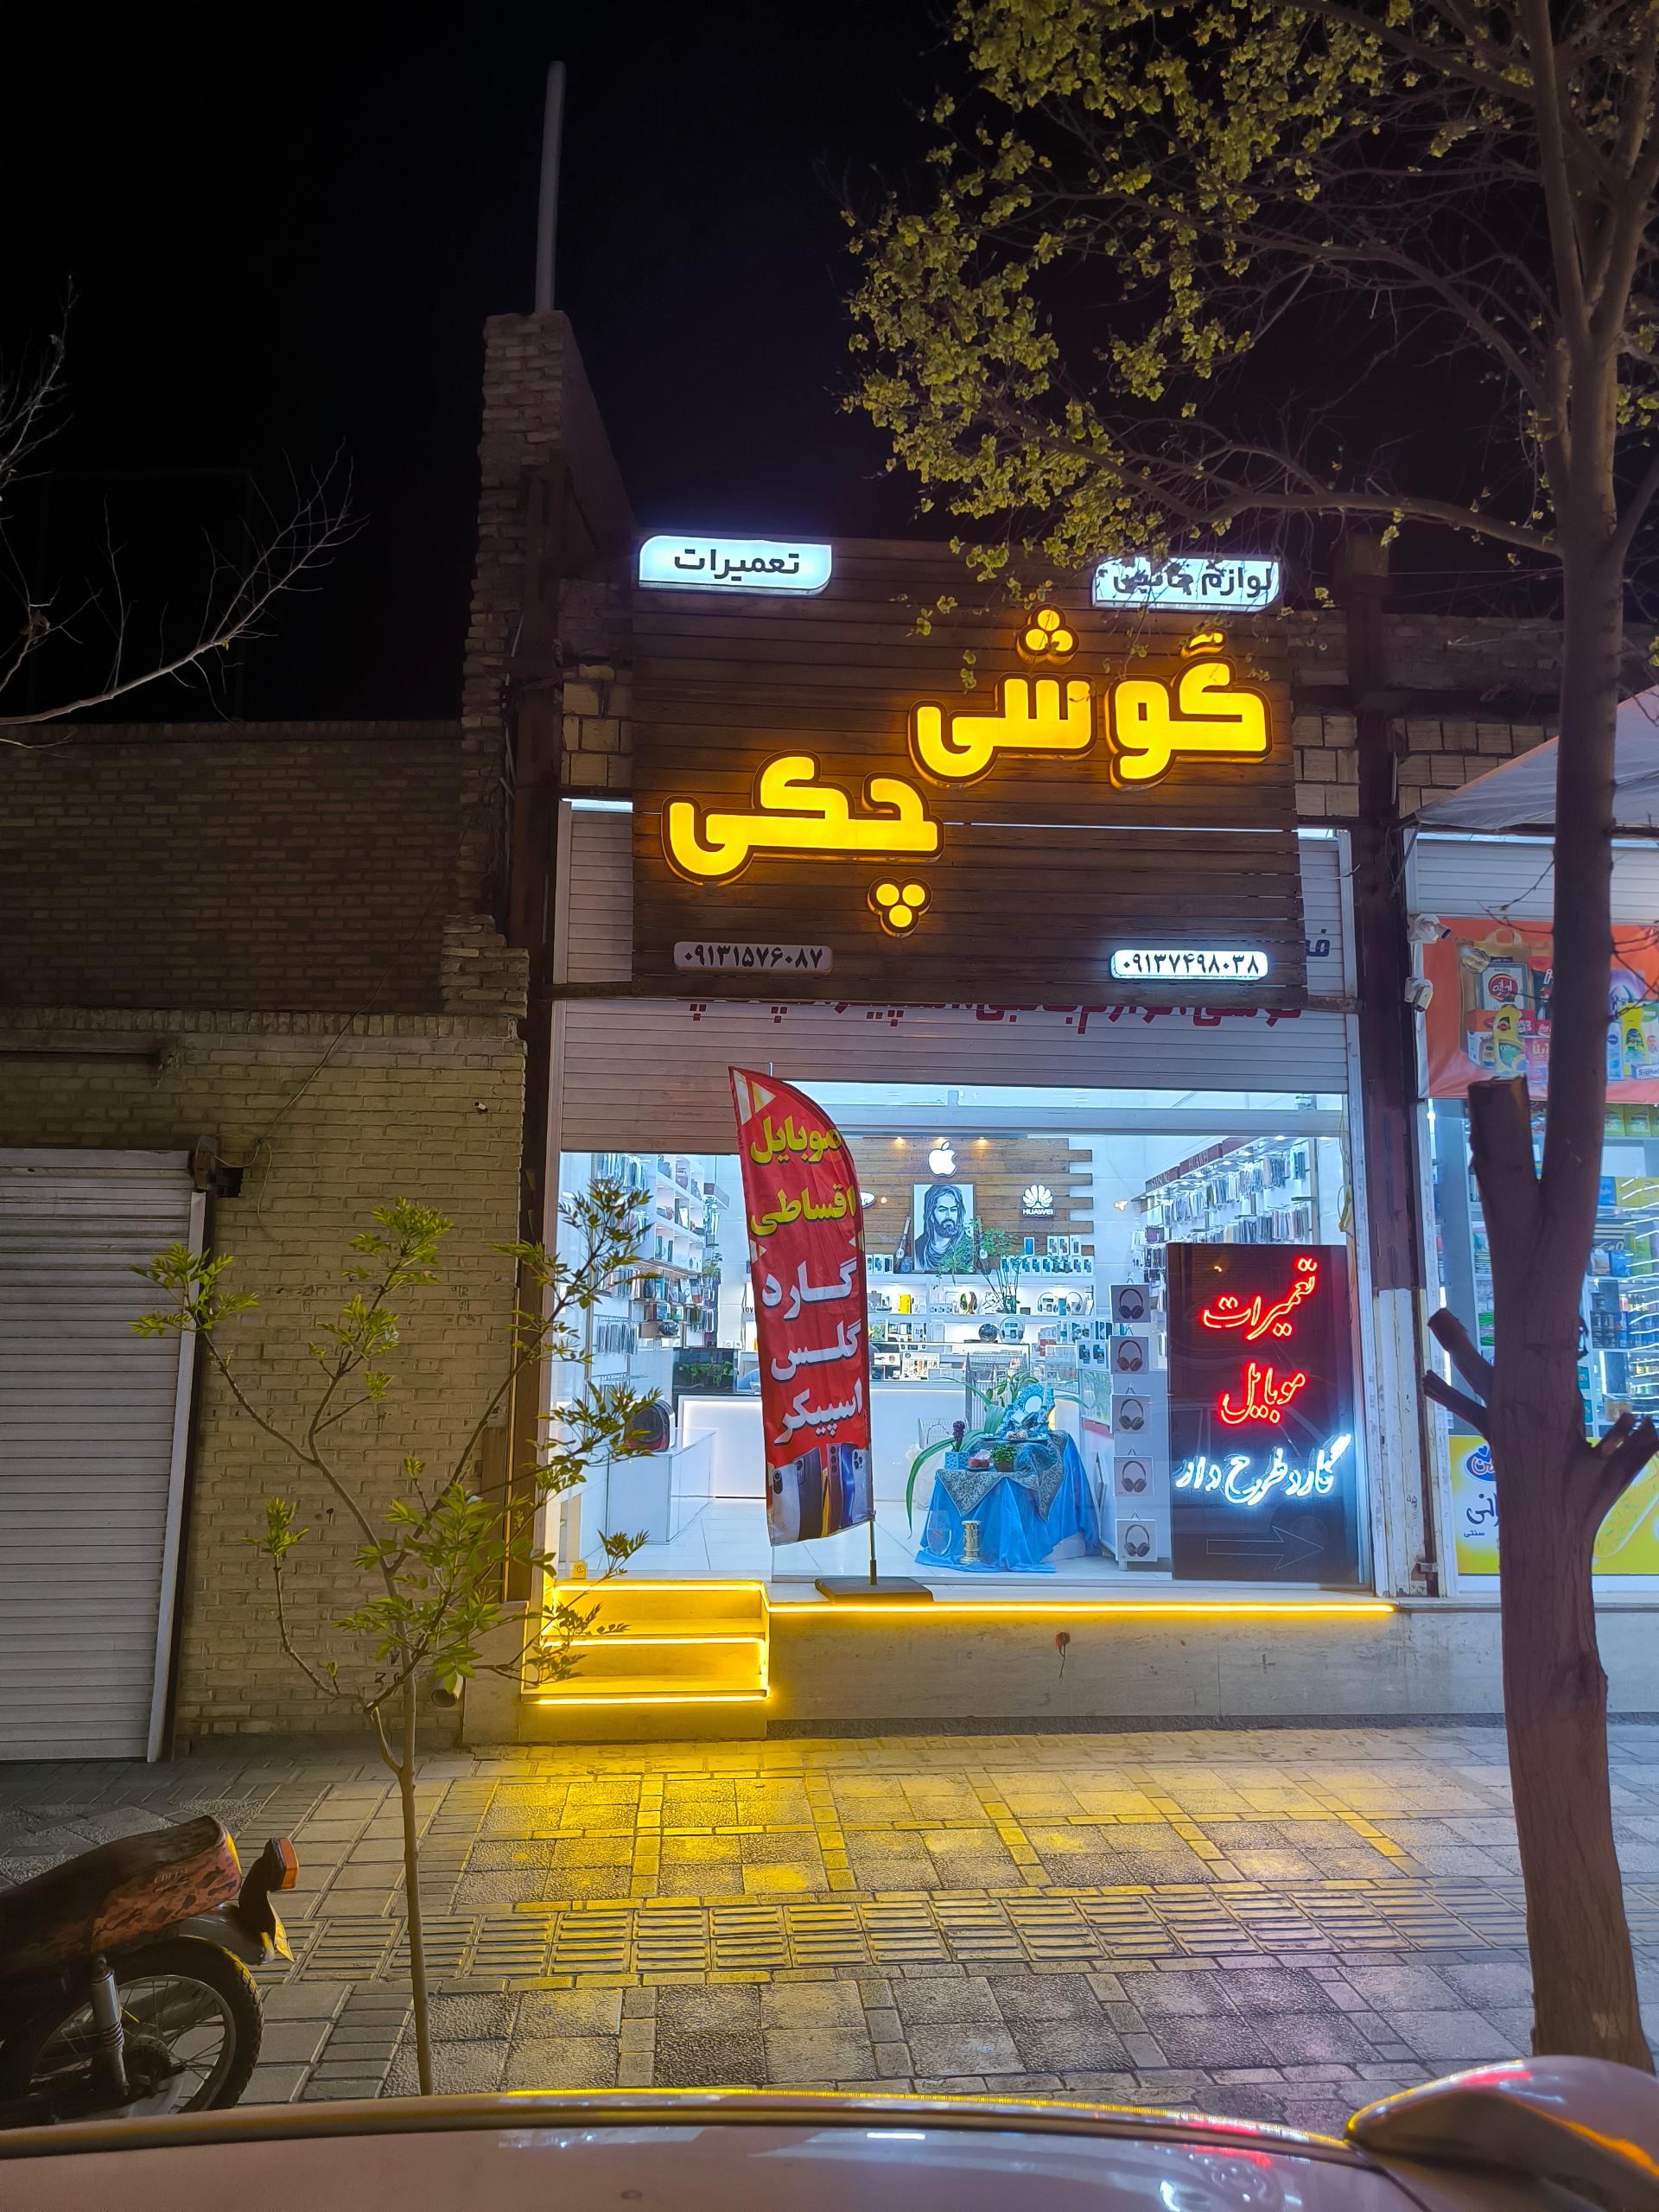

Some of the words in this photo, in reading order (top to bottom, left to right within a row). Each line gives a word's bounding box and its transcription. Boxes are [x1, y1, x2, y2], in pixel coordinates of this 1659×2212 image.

[674, 548, 800, 582] تعمیرات
[1201, 567, 1273, 599] لوازم
[916, 607, 1268, 782] گوشی
[668, 753, 939, 929] چکی
[683, 944, 823, 969] ۰۹۱۳۱۵۷۶۰۸۷
[1122, 951, 1260, 975] ۰۹۱۳۷۴۹۸۰۳۸
[749, 1115, 842, 1165] موبایل
[750, 1183, 857, 1236] اقساطی
[761, 1256, 858, 1321] گارد
[1202, 1256, 1319, 1340] تعمیرات
[770, 1319, 862, 1382] گلس
[773, 1377, 863, 1446] اسپیکر
[1219, 1362, 1306, 1425] موبایل
[1175, 1455, 1222, 1493] دار
[1224, 1446, 1288, 1505] طرح
[1286, 1433, 1352, 1497] گارد
